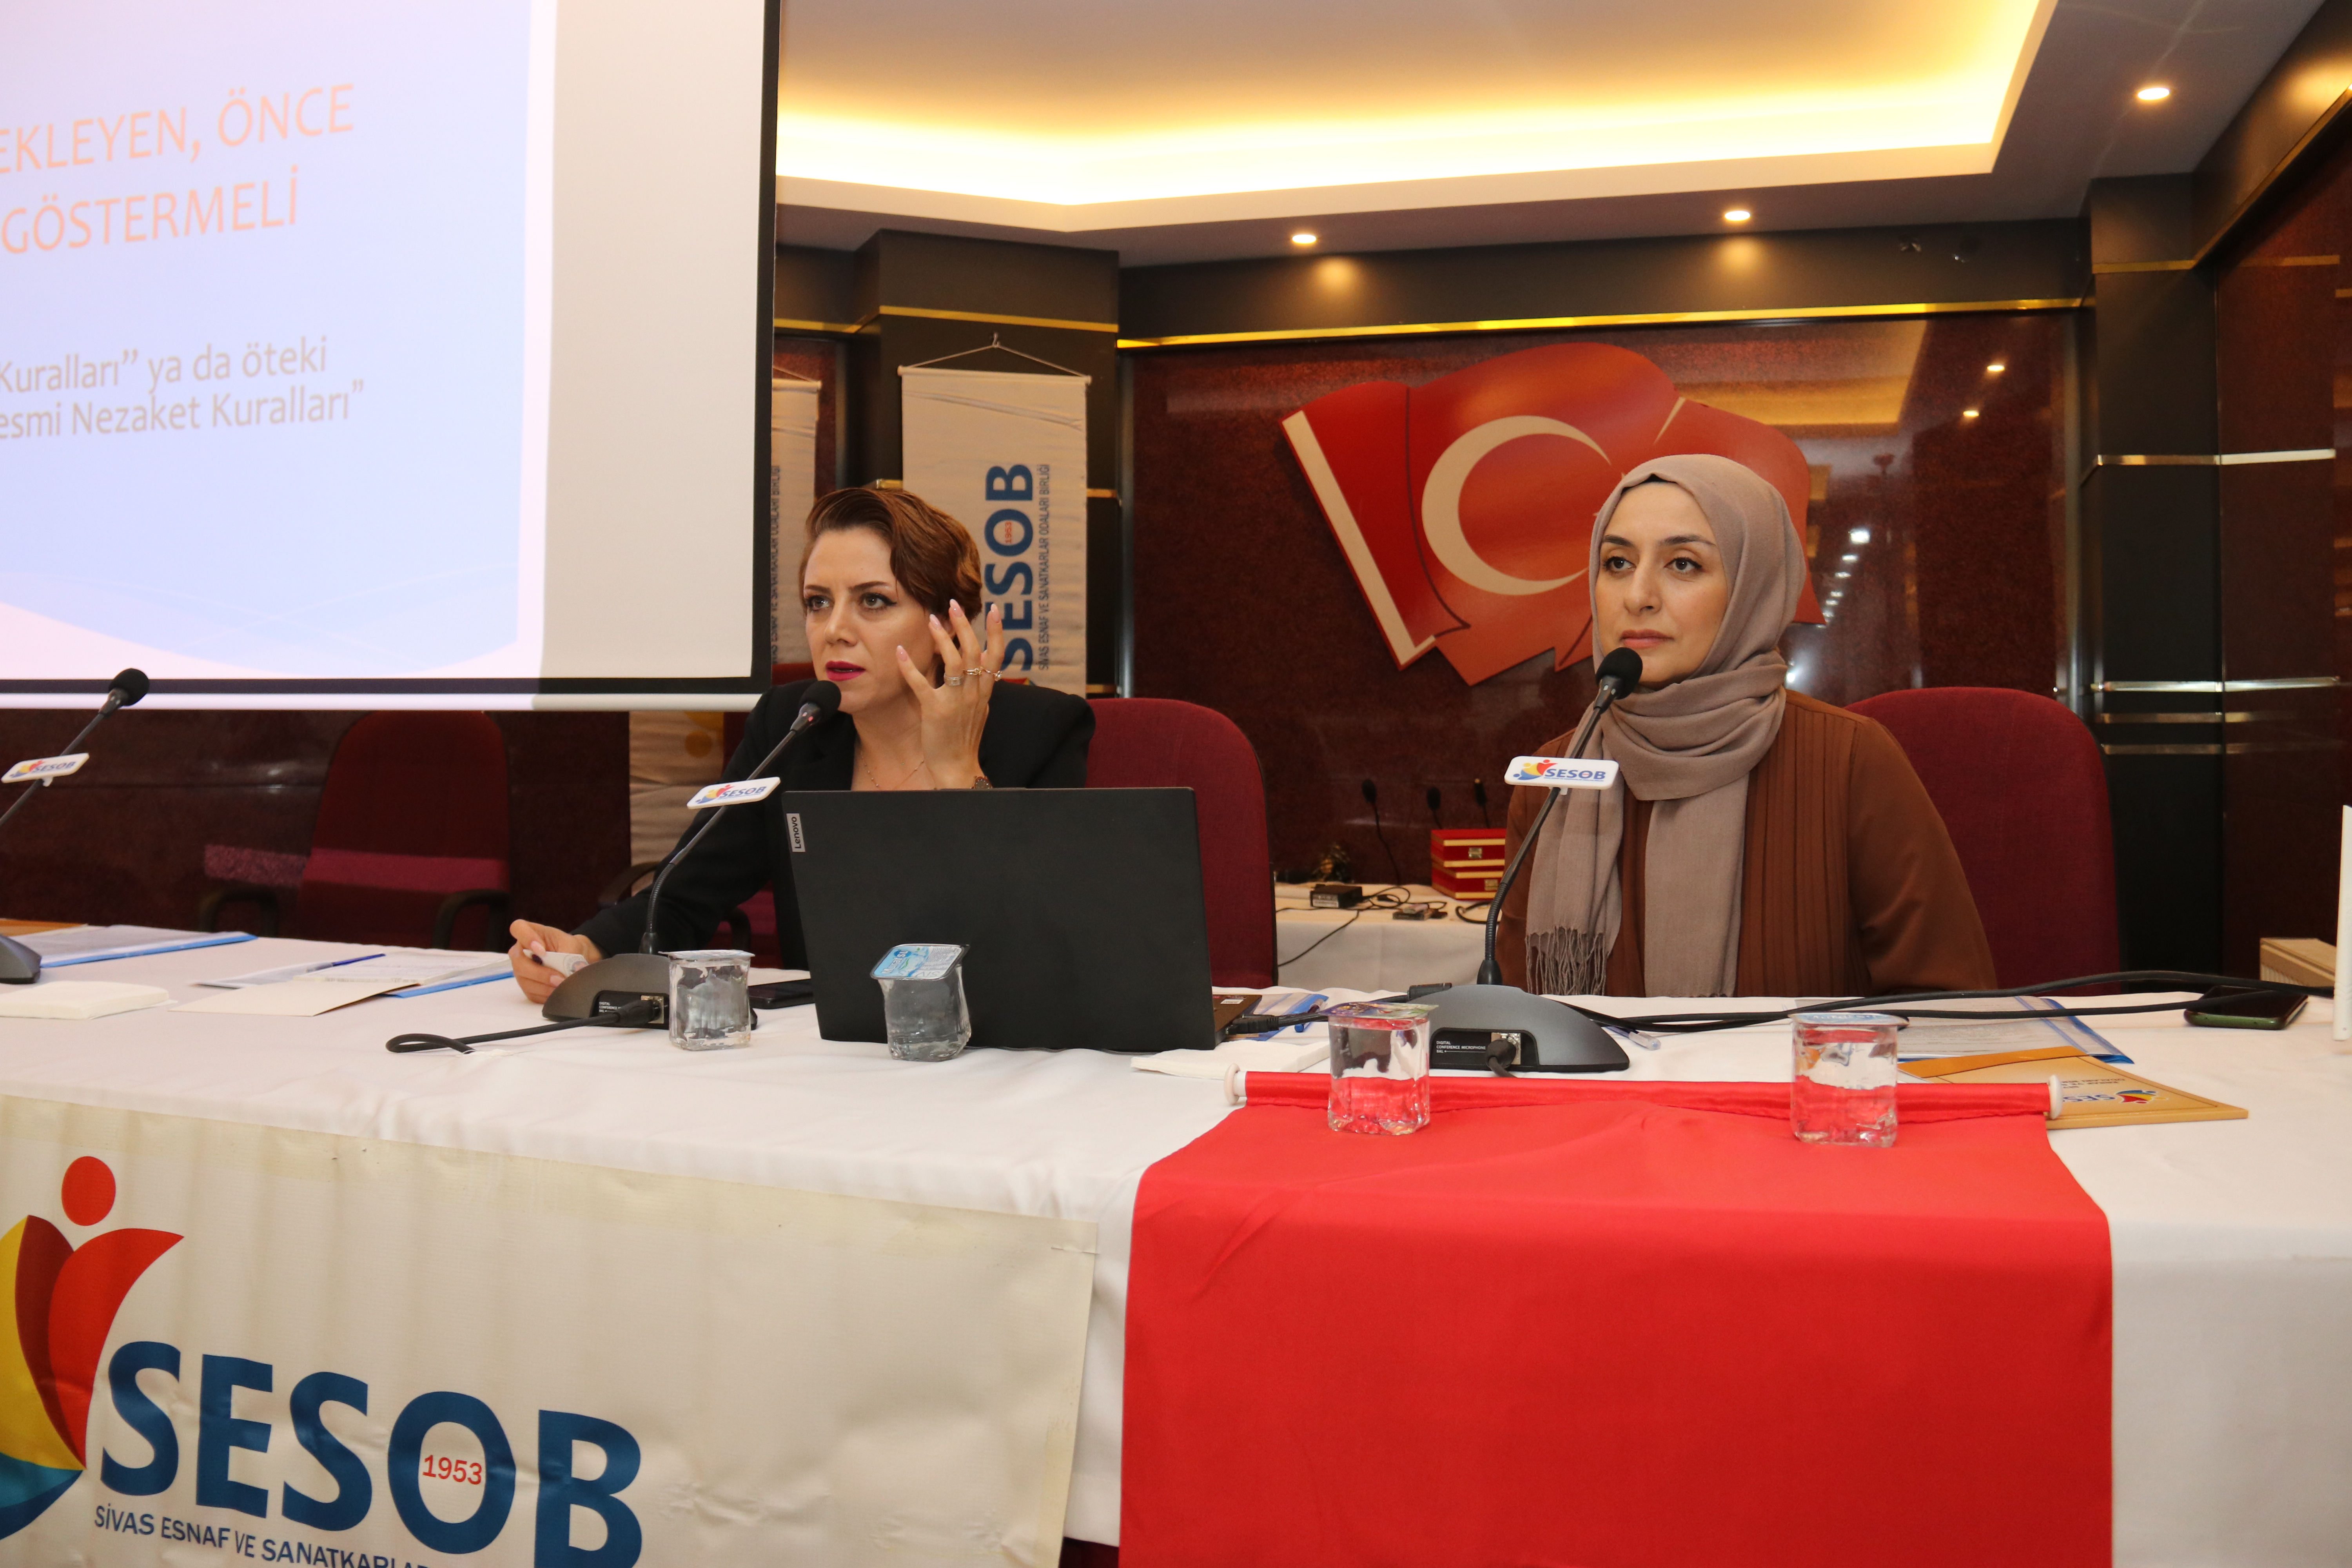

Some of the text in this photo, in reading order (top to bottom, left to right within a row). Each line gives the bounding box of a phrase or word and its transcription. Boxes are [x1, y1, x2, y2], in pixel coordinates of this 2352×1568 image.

[218, 83, 354, 147] ÖNCE
[2, 164, 298, 254] GÖSTERMELİ
[147, 355, 182, 395] ya
[192, 343, 230, 381] da
[242, 335, 327, 378] öteki
[72, 394, 201, 435] Nezaket
[1039, 497, 1049, 535] ODALARI
[984, 464, 1033, 671] SESOB
[1038, 538, 1049, 601] SANATKARLAR
[1039, 603, 1049, 613] VE
[1039, 616, 1049, 644] ESNAF
[720, 786, 767, 798] SESOB
[1544, 769, 1606, 780] SESOB
[791, 817, 802, 849] Lenovo
[100, 1341, 642, 1568] SESOB
[422, 1454, 483, 1486] 1953
[94, 1503, 155, 1535] SİVAS
[161, 1516, 230, 1548] ESNAF
[234, 1530, 256, 1558] VE
